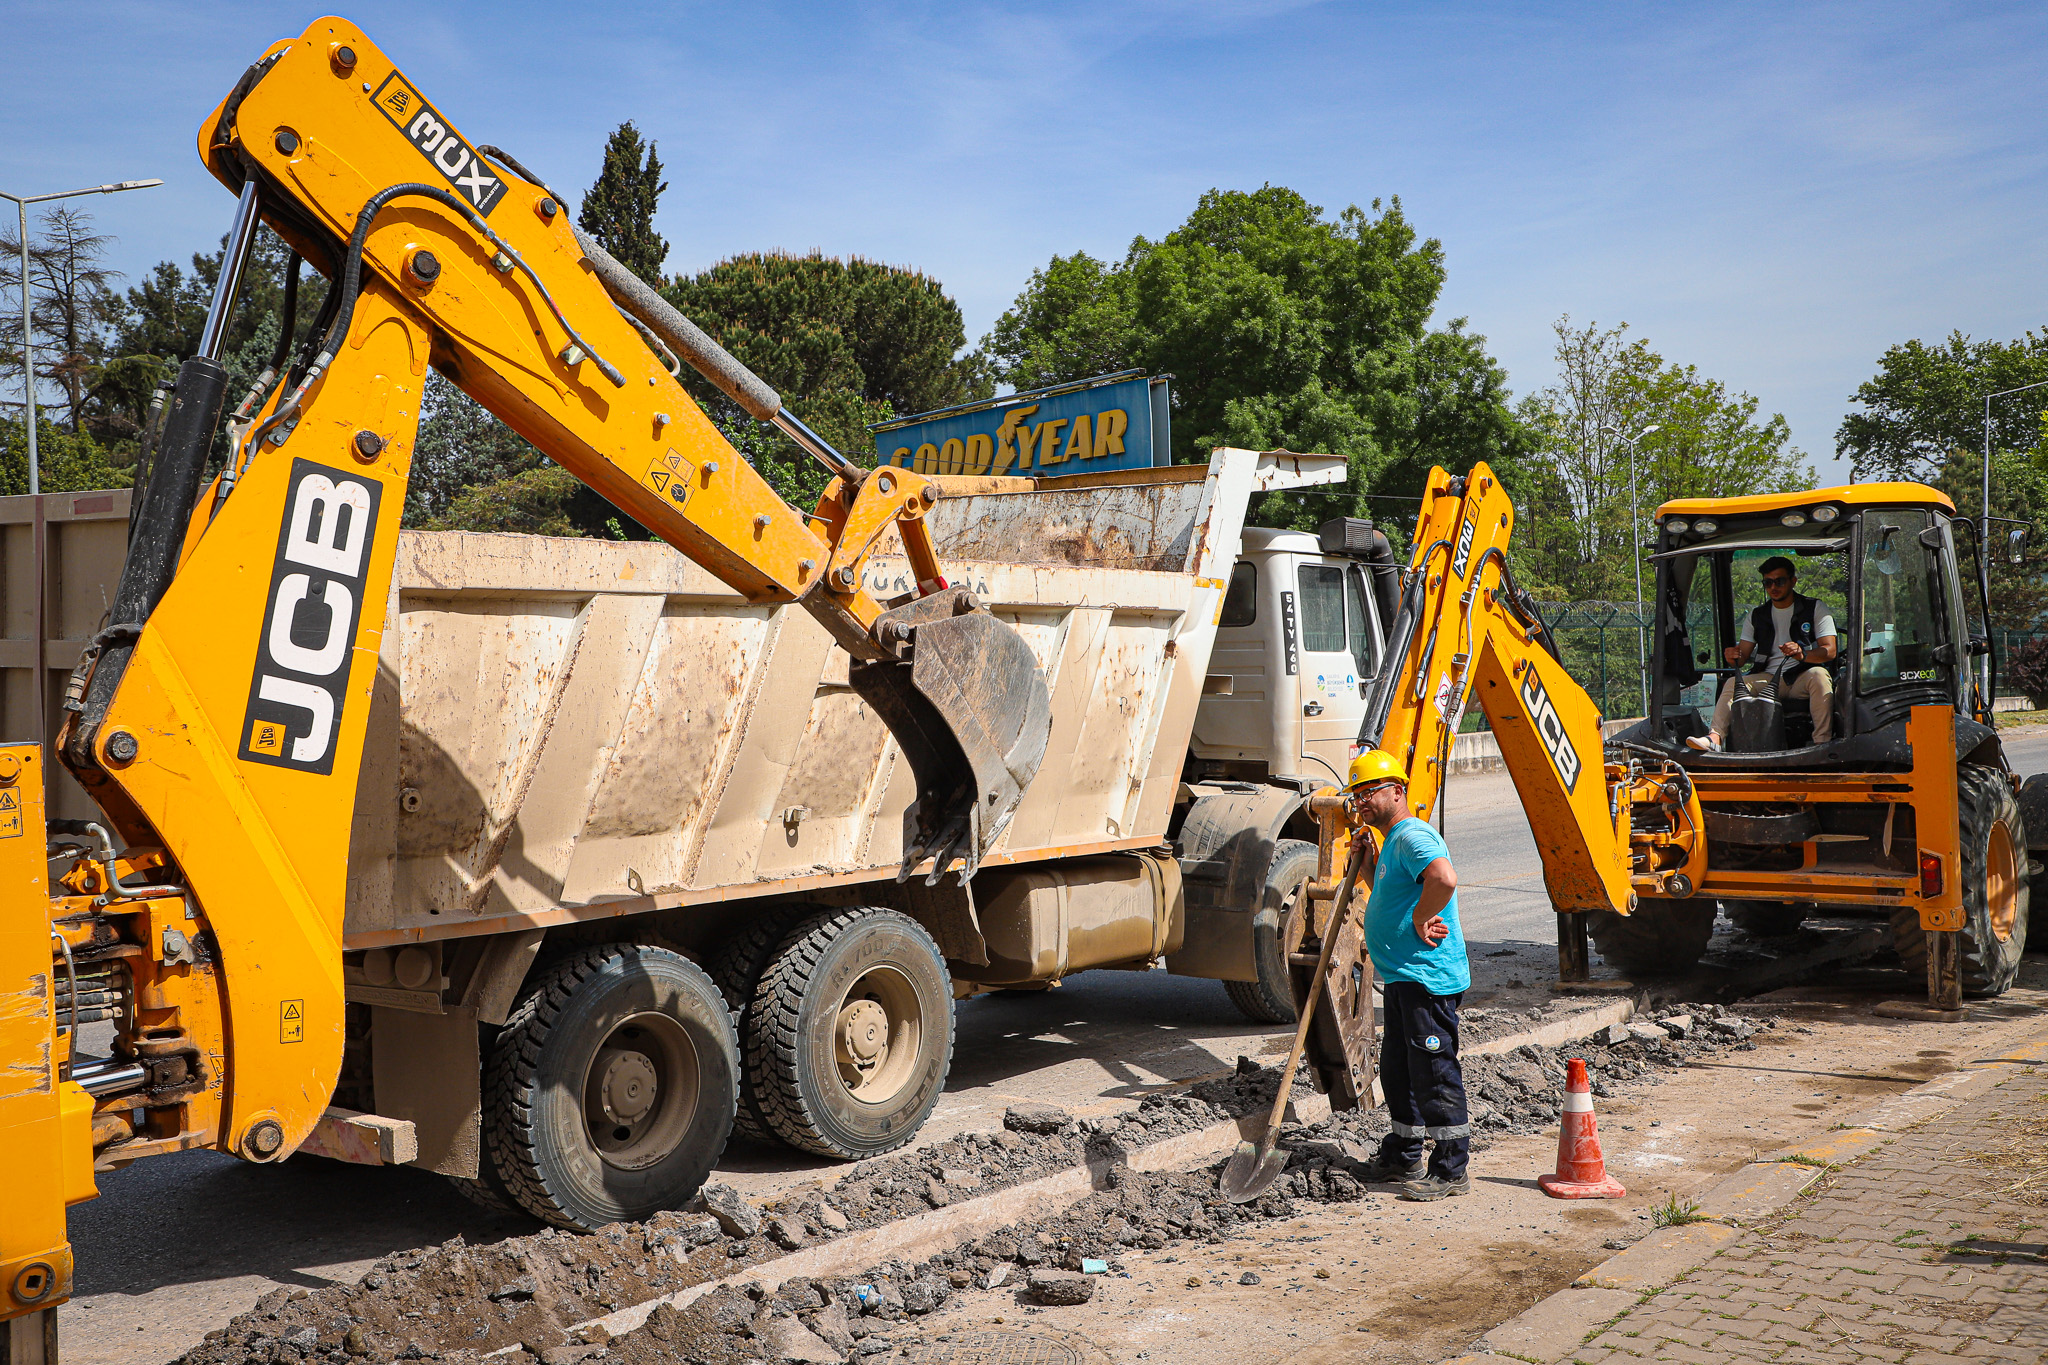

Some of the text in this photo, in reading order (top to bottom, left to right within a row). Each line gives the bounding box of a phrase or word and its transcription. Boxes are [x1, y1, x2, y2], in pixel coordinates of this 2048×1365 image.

[388, 91, 408, 113] JCB
[410, 111, 497, 206] 3CX
[478, 182, 500, 209] SITEMASTER
[1454, 520, 1474, 575] 3CX
[258, 473, 371, 763] JCB
[1285, 593, 1297, 673] 54 TY 460
[258, 727, 273, 744] JCB
[1524, 682, 1578, 787] JCB
